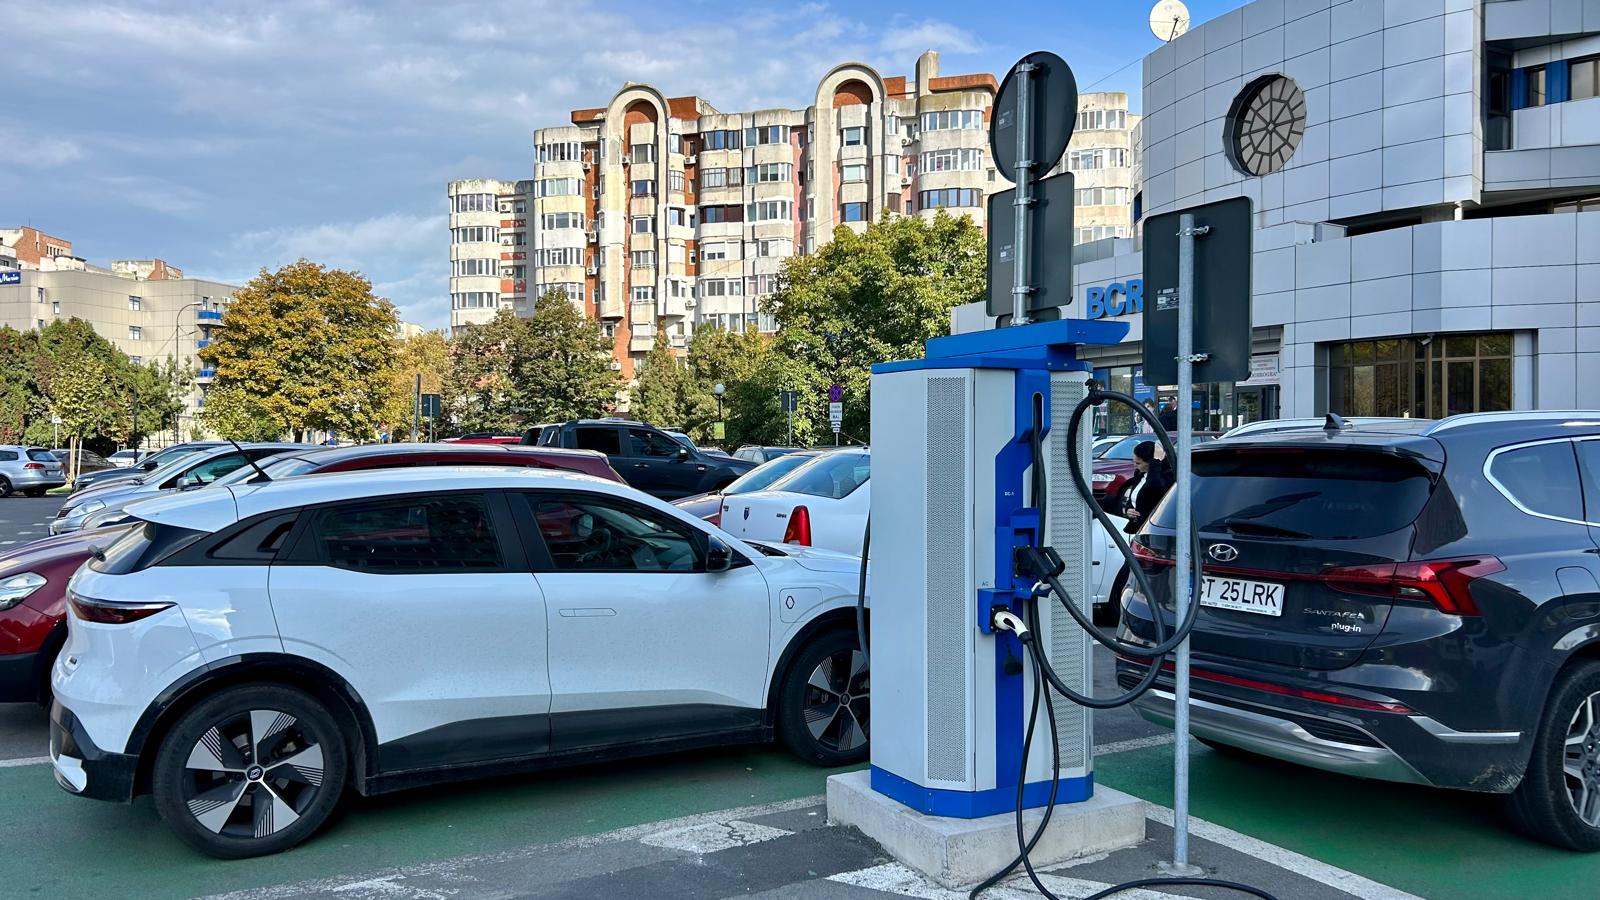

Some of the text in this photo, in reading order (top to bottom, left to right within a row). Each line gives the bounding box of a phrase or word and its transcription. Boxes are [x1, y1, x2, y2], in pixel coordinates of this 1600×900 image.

[1086, 279, 1143, 320] BCR
[1220, 580, 1240, 601] 25
[1241, 583, 1279, 607] LRK
[1330, 622, 1362, 633] plug-in
